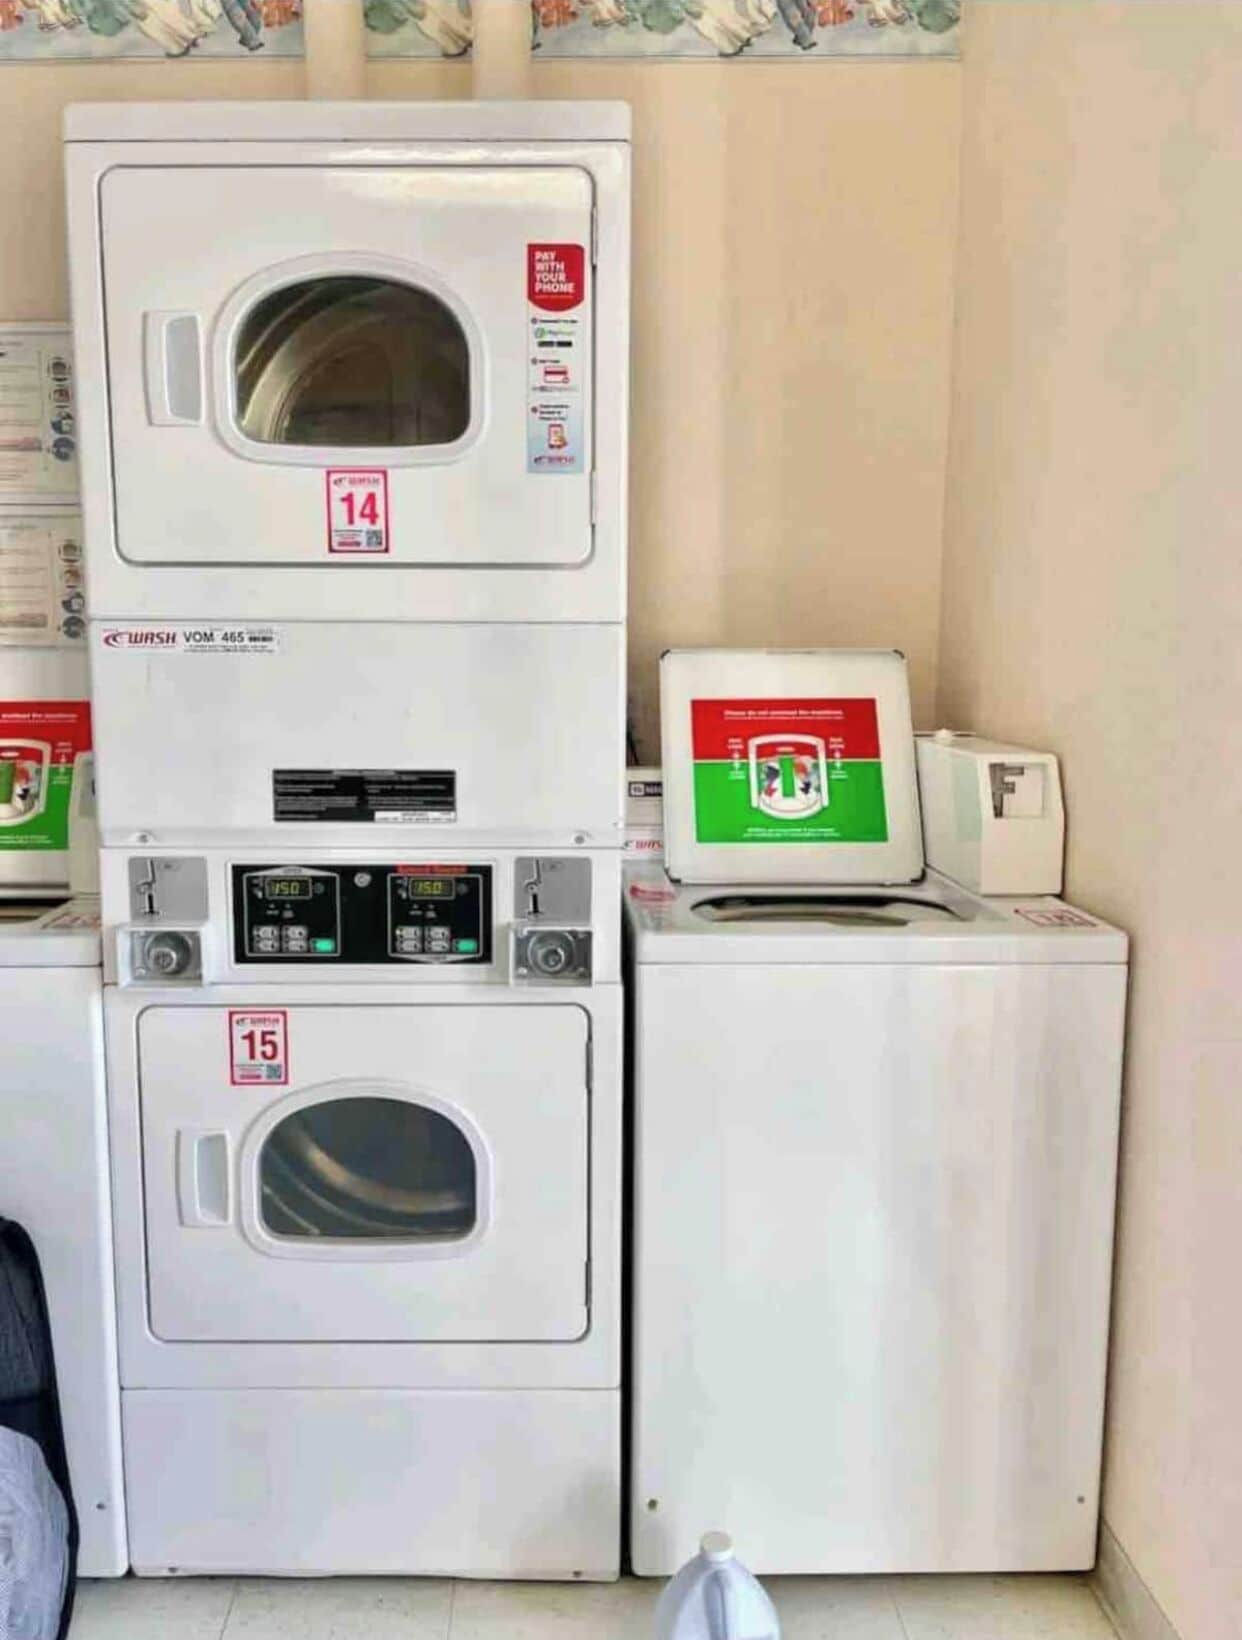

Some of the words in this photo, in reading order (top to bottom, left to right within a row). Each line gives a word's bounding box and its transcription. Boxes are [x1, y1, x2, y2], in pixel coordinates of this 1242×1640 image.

[535, 251, 556, 261] PAY
[535, 261, 565, 272] WITH
[535, 271, 566, 282] YOUR
[535, 282, 575, 293] PHONE
[340, 491, 380, 525] 14
[128, 631, 177, 644] WASH
[183, 631, 215, 643] VOM
[221, 631, 245, 643] 465
[241, 1029, 278, 1061] 15
